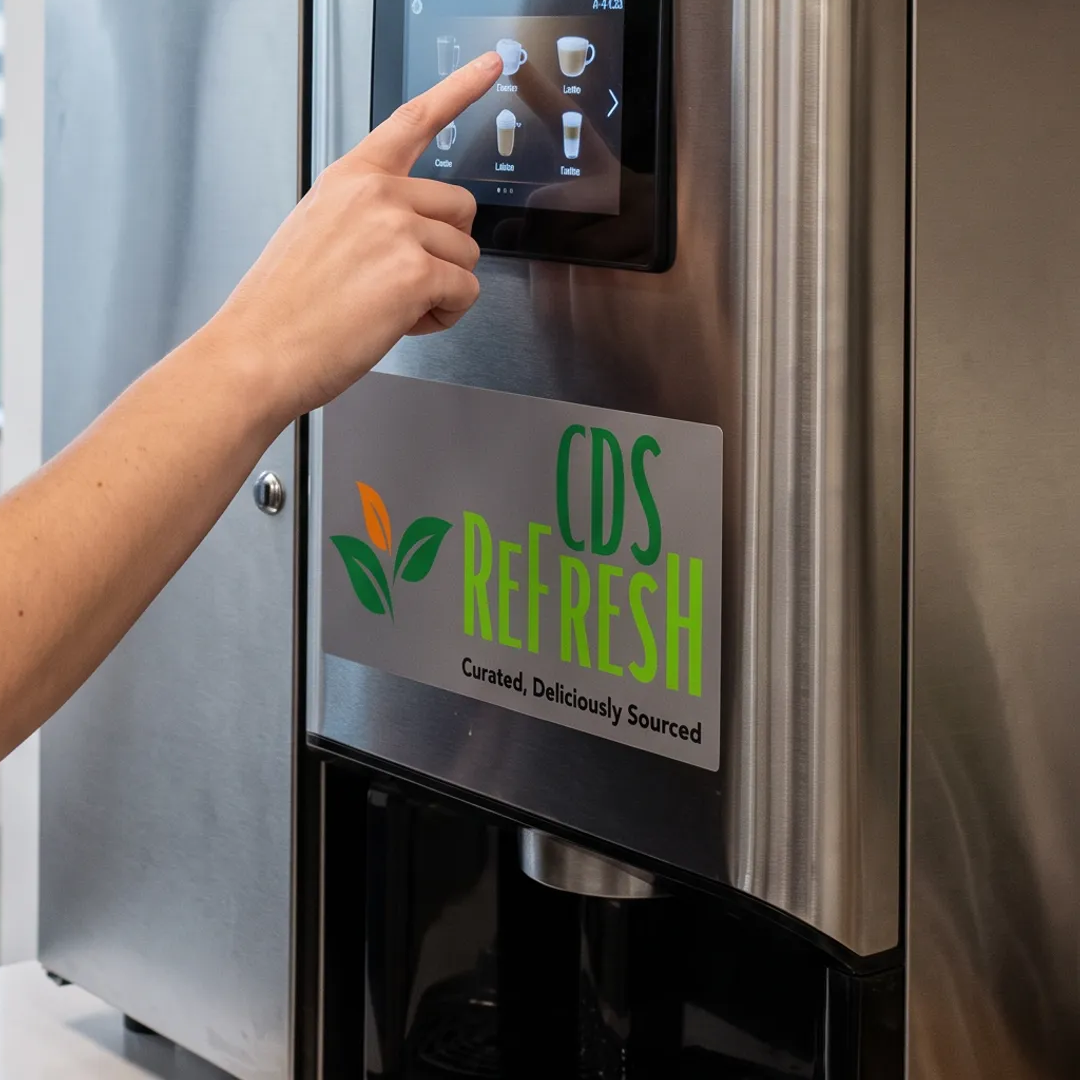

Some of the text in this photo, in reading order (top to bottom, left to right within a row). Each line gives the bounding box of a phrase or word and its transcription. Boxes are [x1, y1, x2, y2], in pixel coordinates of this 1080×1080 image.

[556, 423, 663, 566] CDS
[462, 510, 703, 698] REFRESH
[461, 657, 703, 745] Curated, Deliciously Sourced
